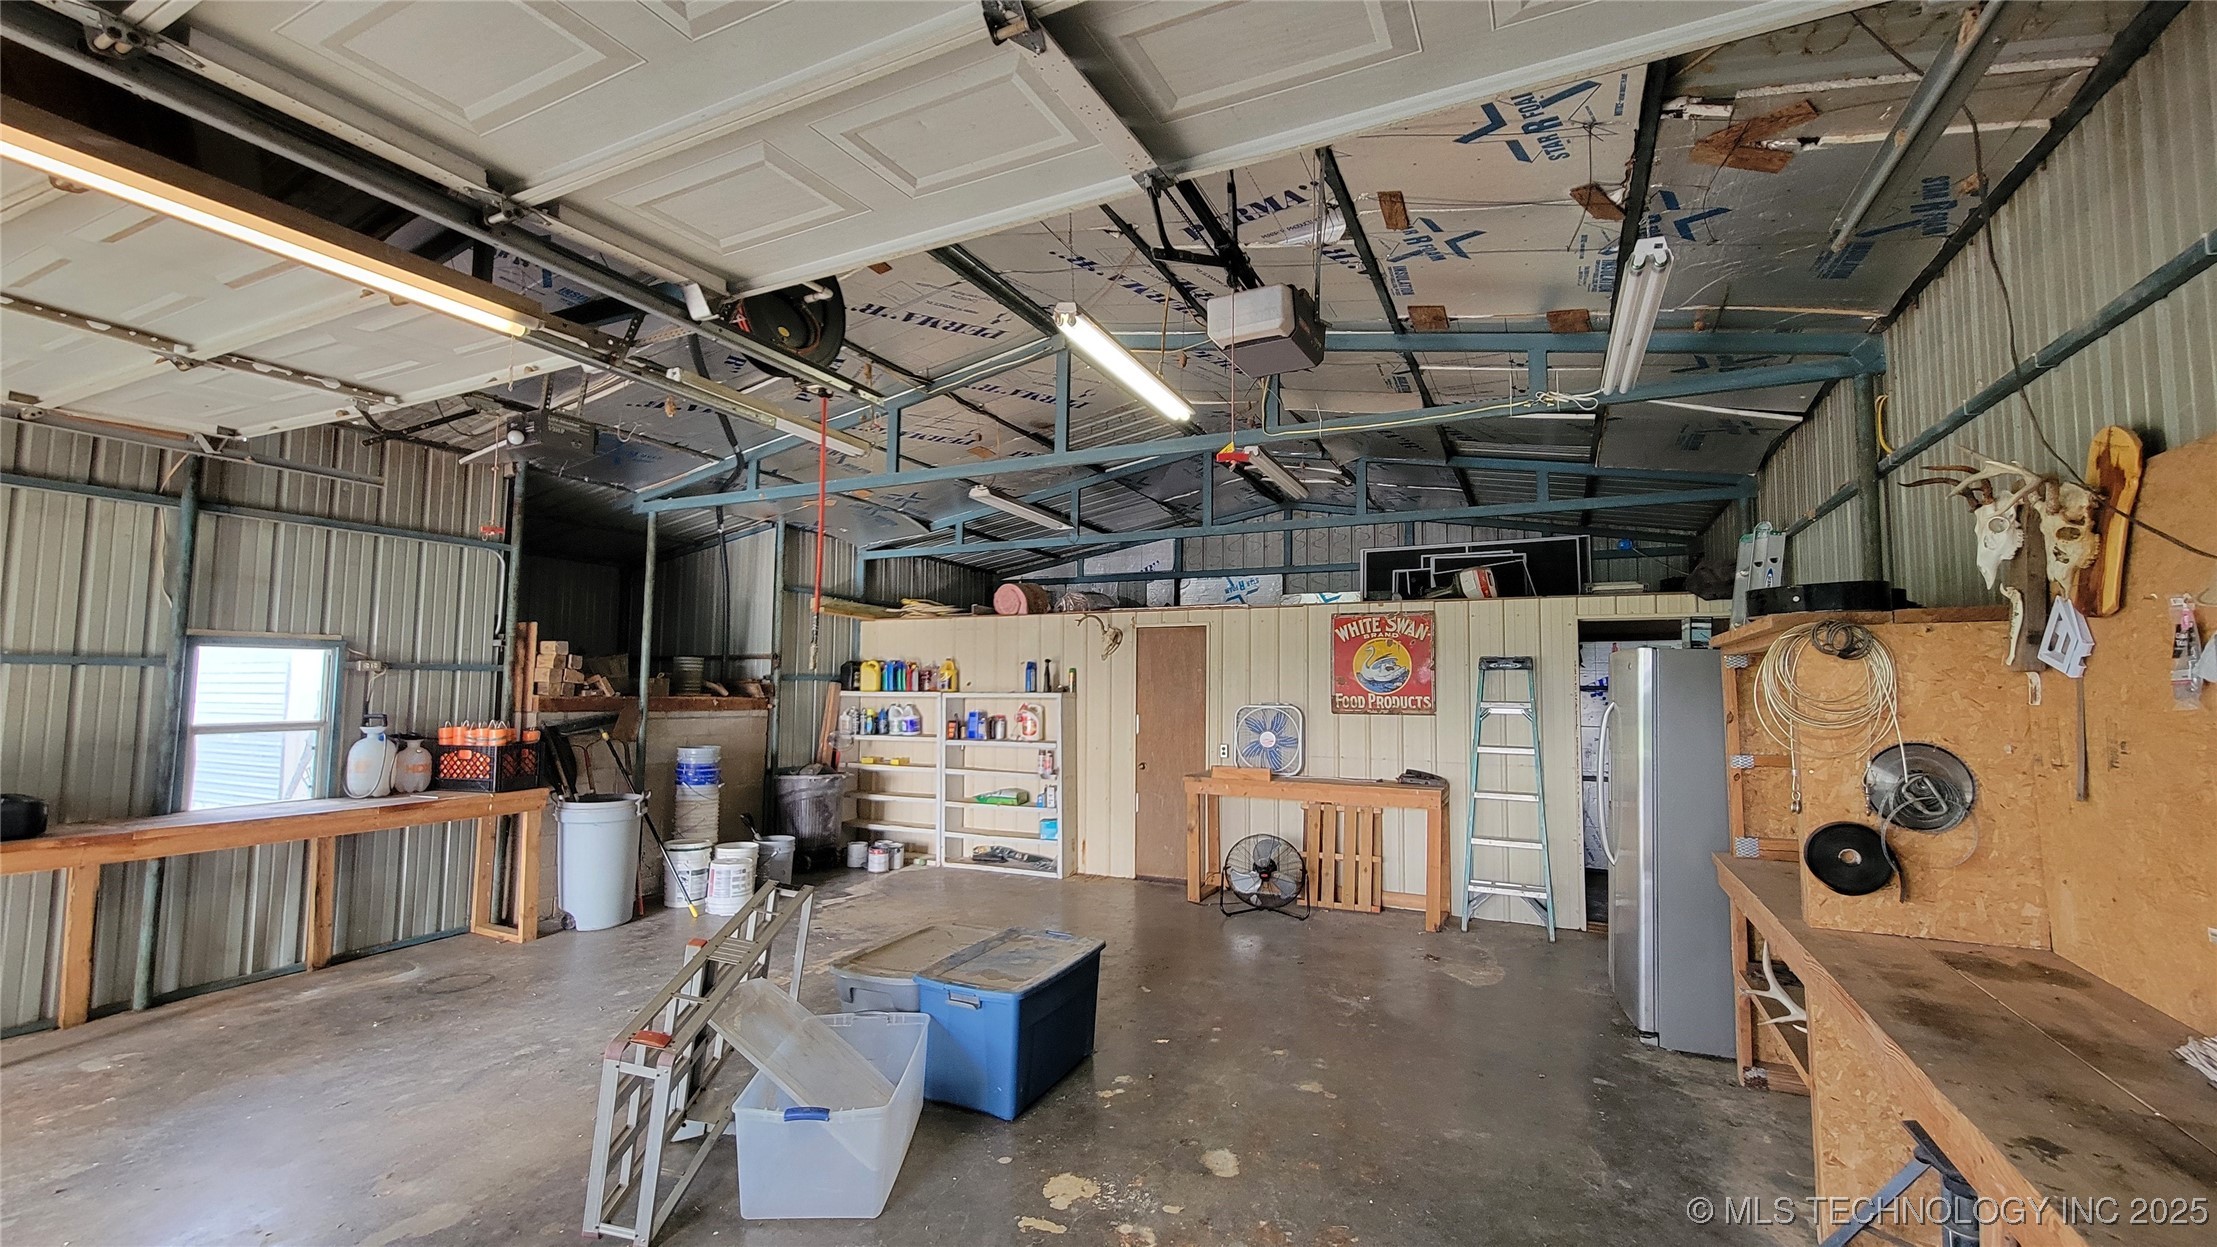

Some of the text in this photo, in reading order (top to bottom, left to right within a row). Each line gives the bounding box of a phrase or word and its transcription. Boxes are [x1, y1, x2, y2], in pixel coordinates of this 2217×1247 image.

[1521, 115, 1564, 135] R
[1537, 133, 1570, 161] STAR
[1182, 189, 1308, 241] PRMA
[1392, 265, 1415, 296] INSULATION
[901, 311, 1008, 340] PERMA
[1334, 617, 1429, 642] WHITE SWAN
[1335, 692, 1432, 709] FOOD PRODUCTS
